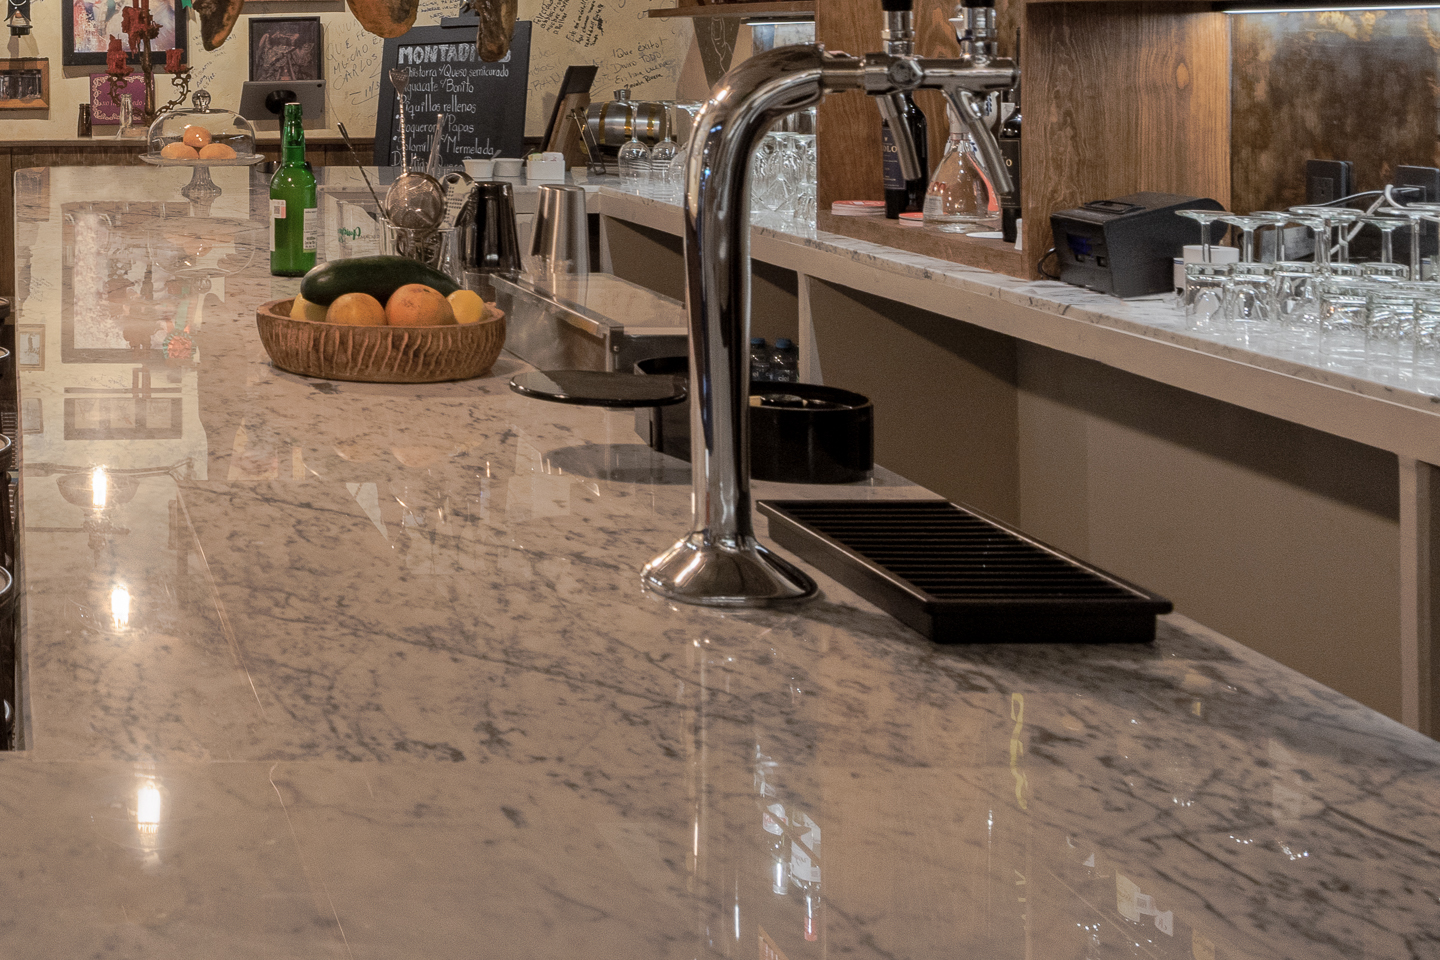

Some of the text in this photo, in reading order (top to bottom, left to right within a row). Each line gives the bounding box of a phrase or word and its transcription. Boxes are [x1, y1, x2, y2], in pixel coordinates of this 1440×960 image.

[333, 52, 378, 91] CARLOS
[404, 66, 437, 78] historra
[468, 63, 509, 78] semicurado
[404, 77, 439, 101] guacate
[443, 94, 477, 114] rellenos
